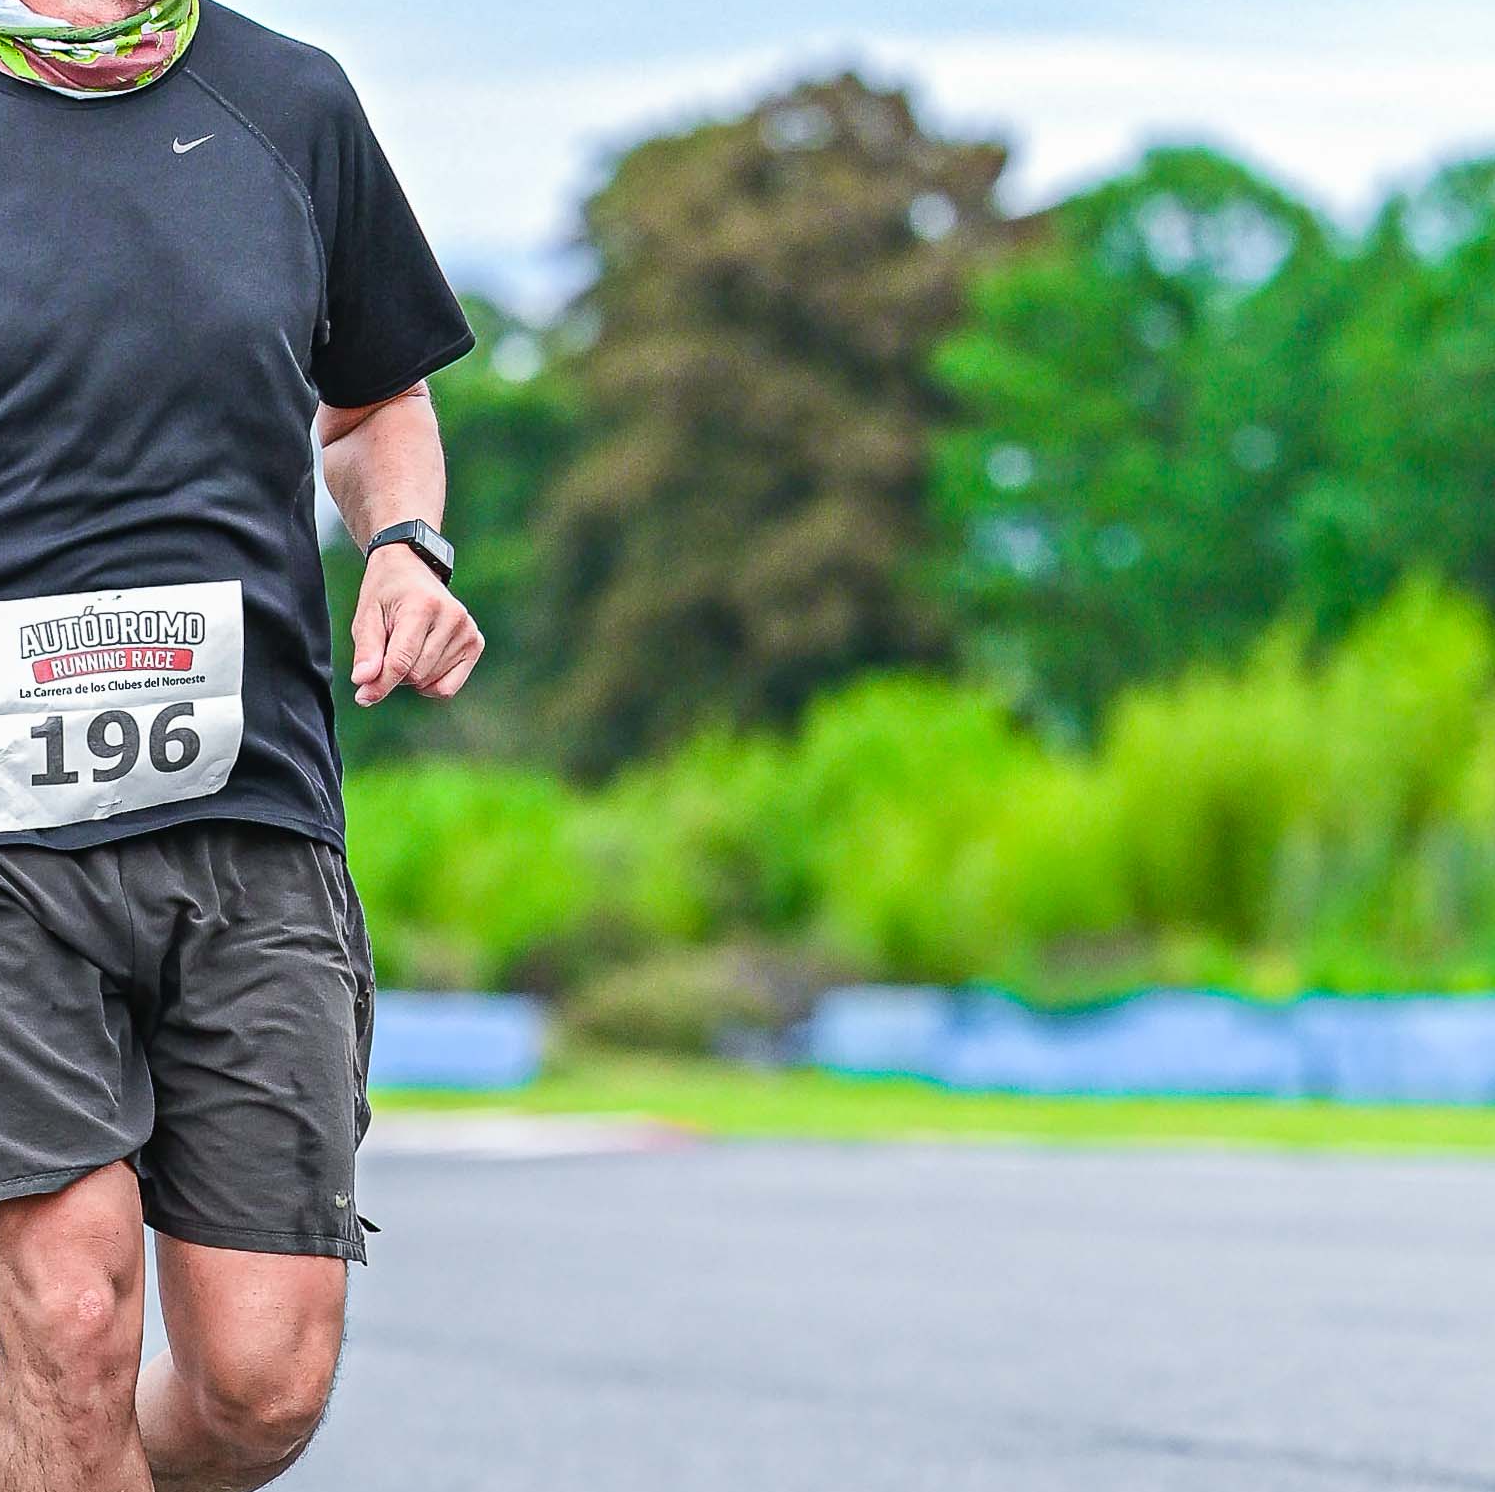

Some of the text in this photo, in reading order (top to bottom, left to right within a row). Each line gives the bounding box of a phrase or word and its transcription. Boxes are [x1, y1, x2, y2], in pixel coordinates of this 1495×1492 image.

[20, 606, 205, 659] AUTÓDROMO
[50, 650, 176, 678] RUNNING RACE
[19, 675, 206, 698] La Carrera de los Clubes del Noroeste
[30, 702, 201, 787] 196
